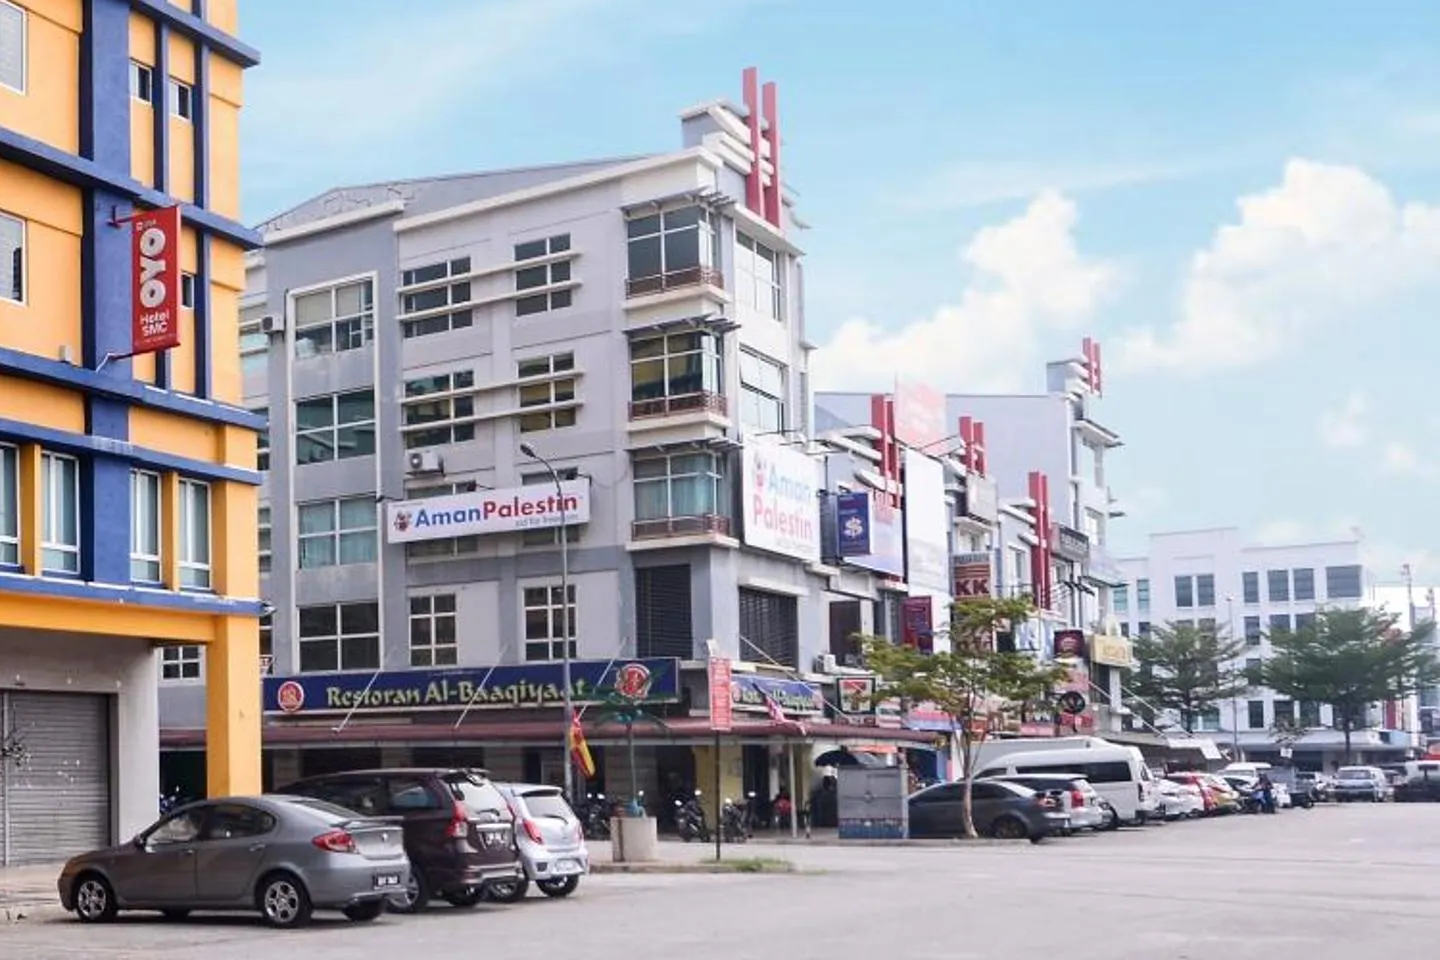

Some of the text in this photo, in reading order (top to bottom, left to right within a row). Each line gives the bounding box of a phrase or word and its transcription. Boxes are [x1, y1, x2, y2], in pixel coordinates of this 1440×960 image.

[140, 228, 166, 308] OYO
[754, 495, 813, 541] Palestin
[326, 686, 420, 708] Restoran
